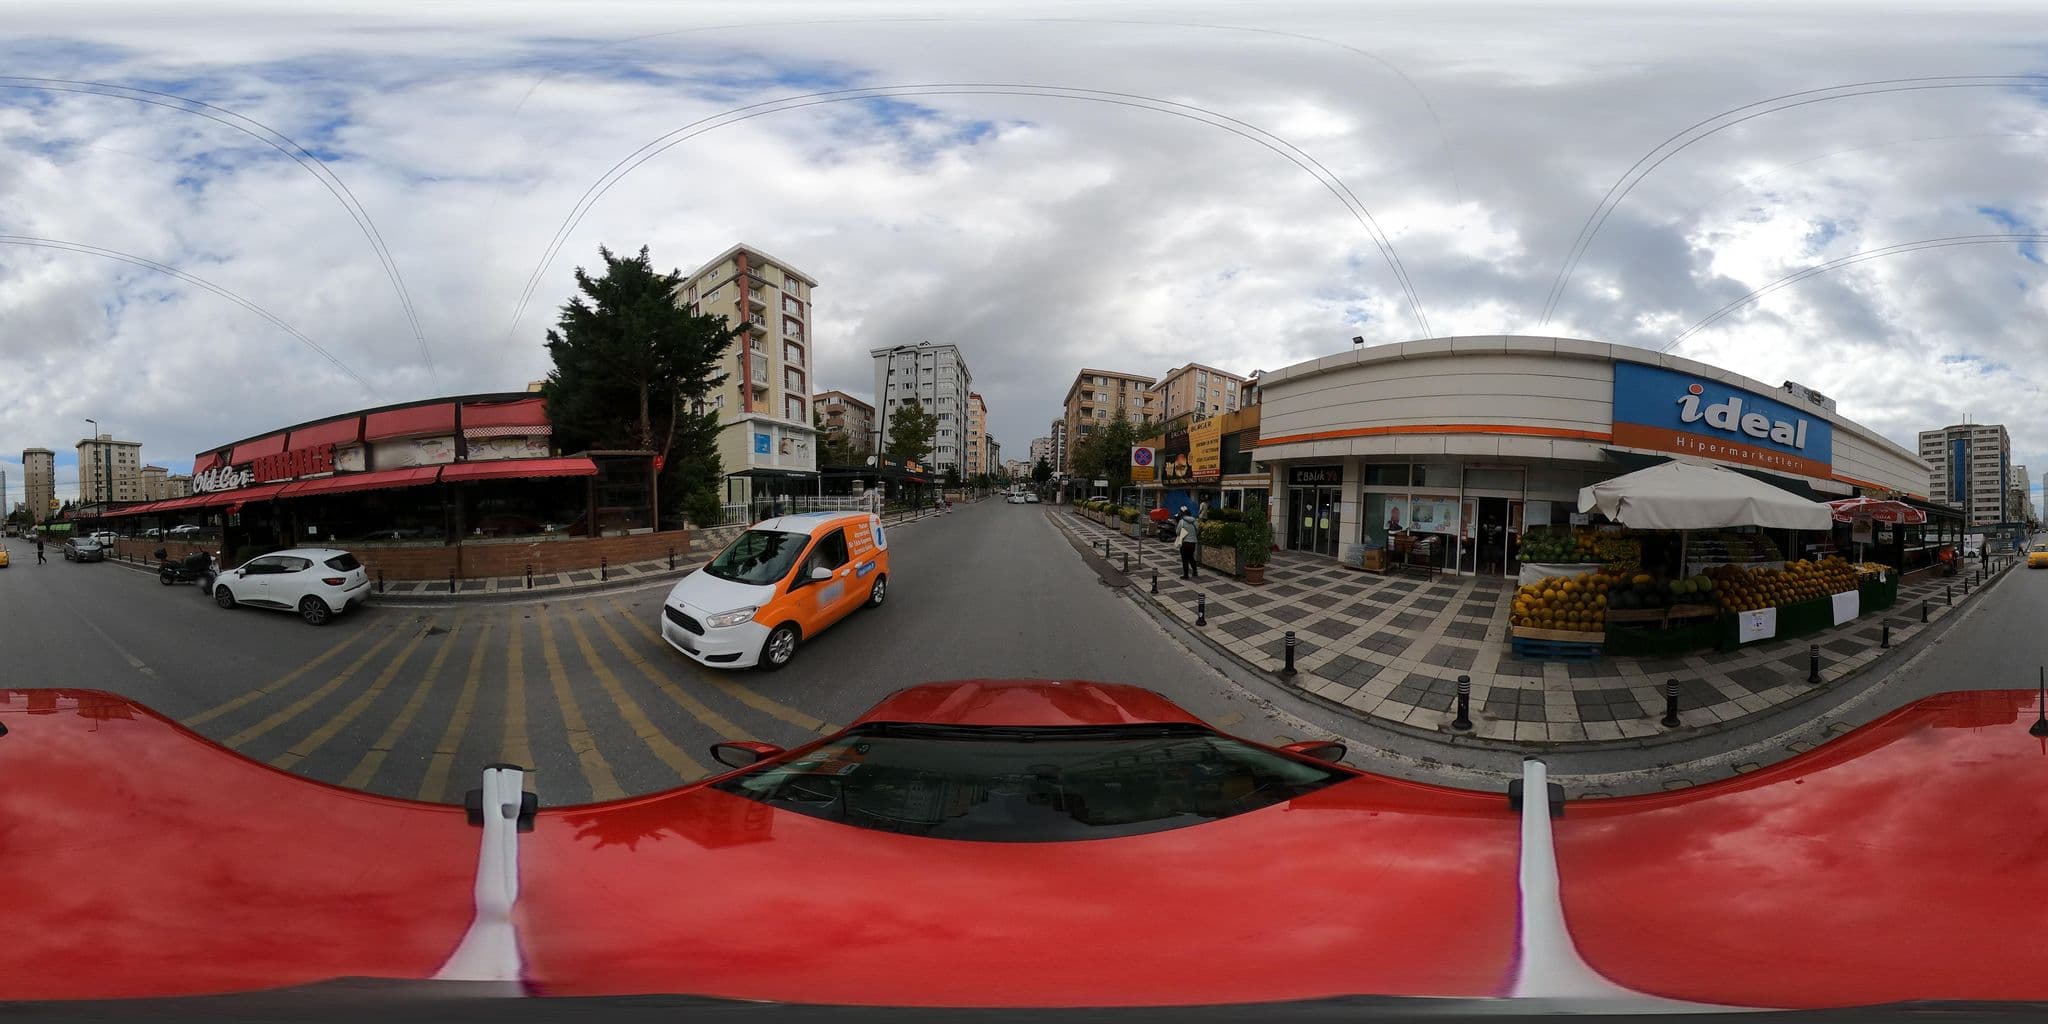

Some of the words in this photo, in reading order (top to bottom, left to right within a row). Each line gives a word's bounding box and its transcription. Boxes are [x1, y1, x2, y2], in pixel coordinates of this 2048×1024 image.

[1677, 383, 1808, 449] ideal
[218, 465, 248, 488] Car
[253, 442, 335, 483] GARAGE
[1676, 436, 1803, 469] Hipermarketleri
